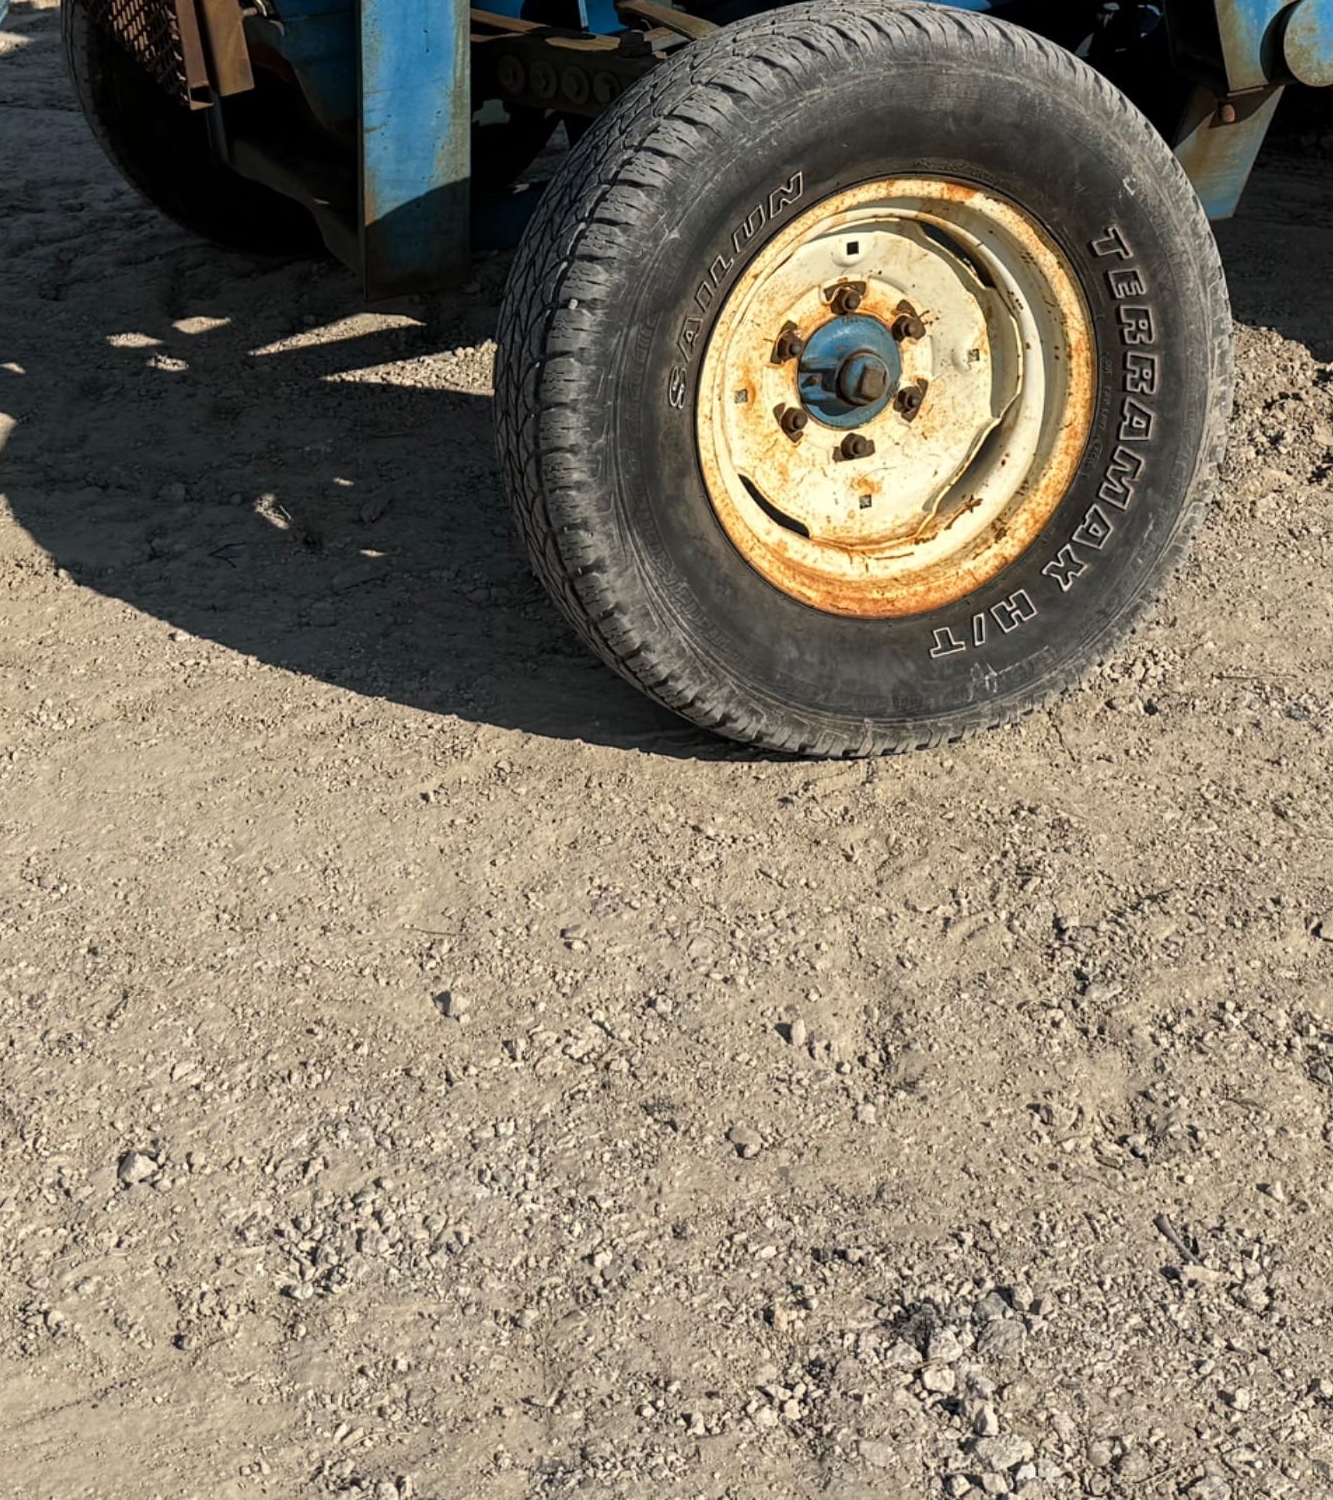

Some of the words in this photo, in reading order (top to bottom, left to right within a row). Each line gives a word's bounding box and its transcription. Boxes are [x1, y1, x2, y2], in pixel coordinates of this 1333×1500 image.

[667, 170, 806, 411] SAILUN
[1041, 225, 1159, 593] TERRAMAX
[928, 588, 1039, 659] H/T
